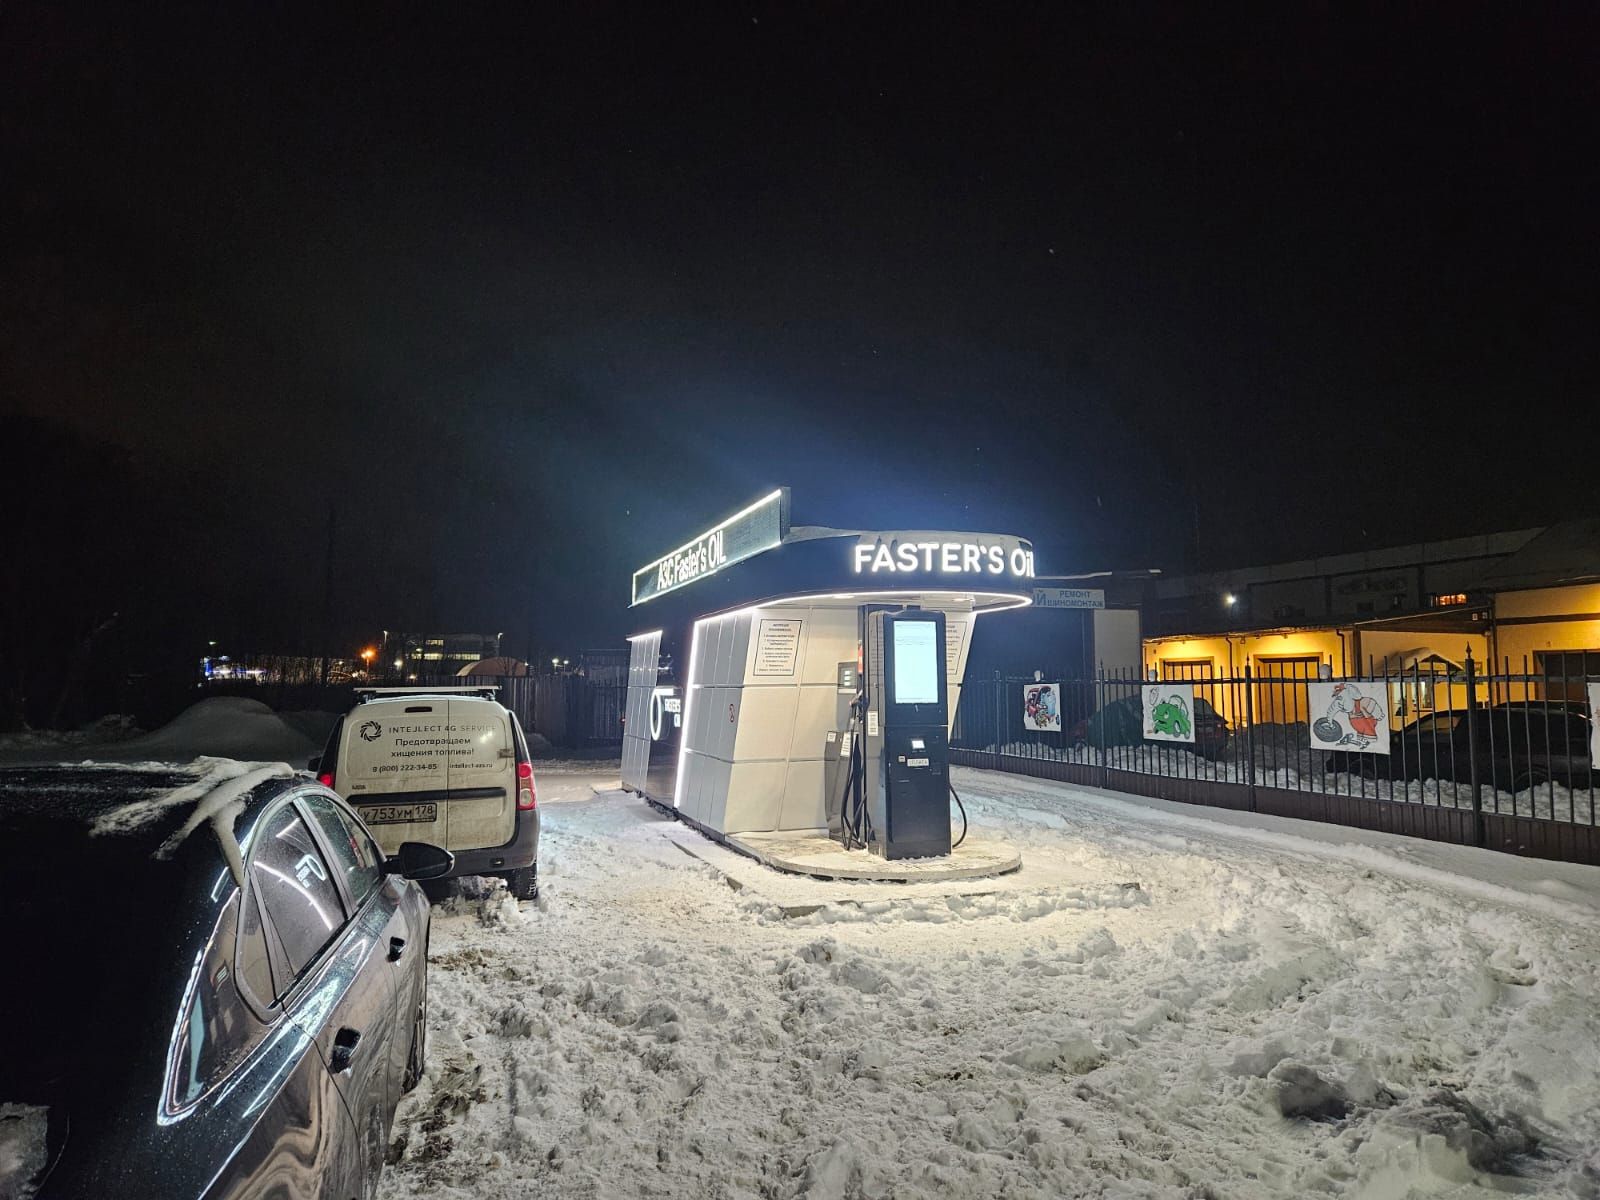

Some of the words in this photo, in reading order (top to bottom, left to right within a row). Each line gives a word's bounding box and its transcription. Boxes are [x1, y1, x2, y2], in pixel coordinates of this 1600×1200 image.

[854, 543, 1005, 574] FASTER'S
[1059, 590, 1090, 599] РЕМОНТ
[1047, 599, 1104, 607] ШИНОМОНТАЖ
[395, 738, 471, 747] Предотвращаем
[391, 750, 433, 758] хищения
[435, 748, 474, 756] топлива!
[415, 805, 433, 815] 178
